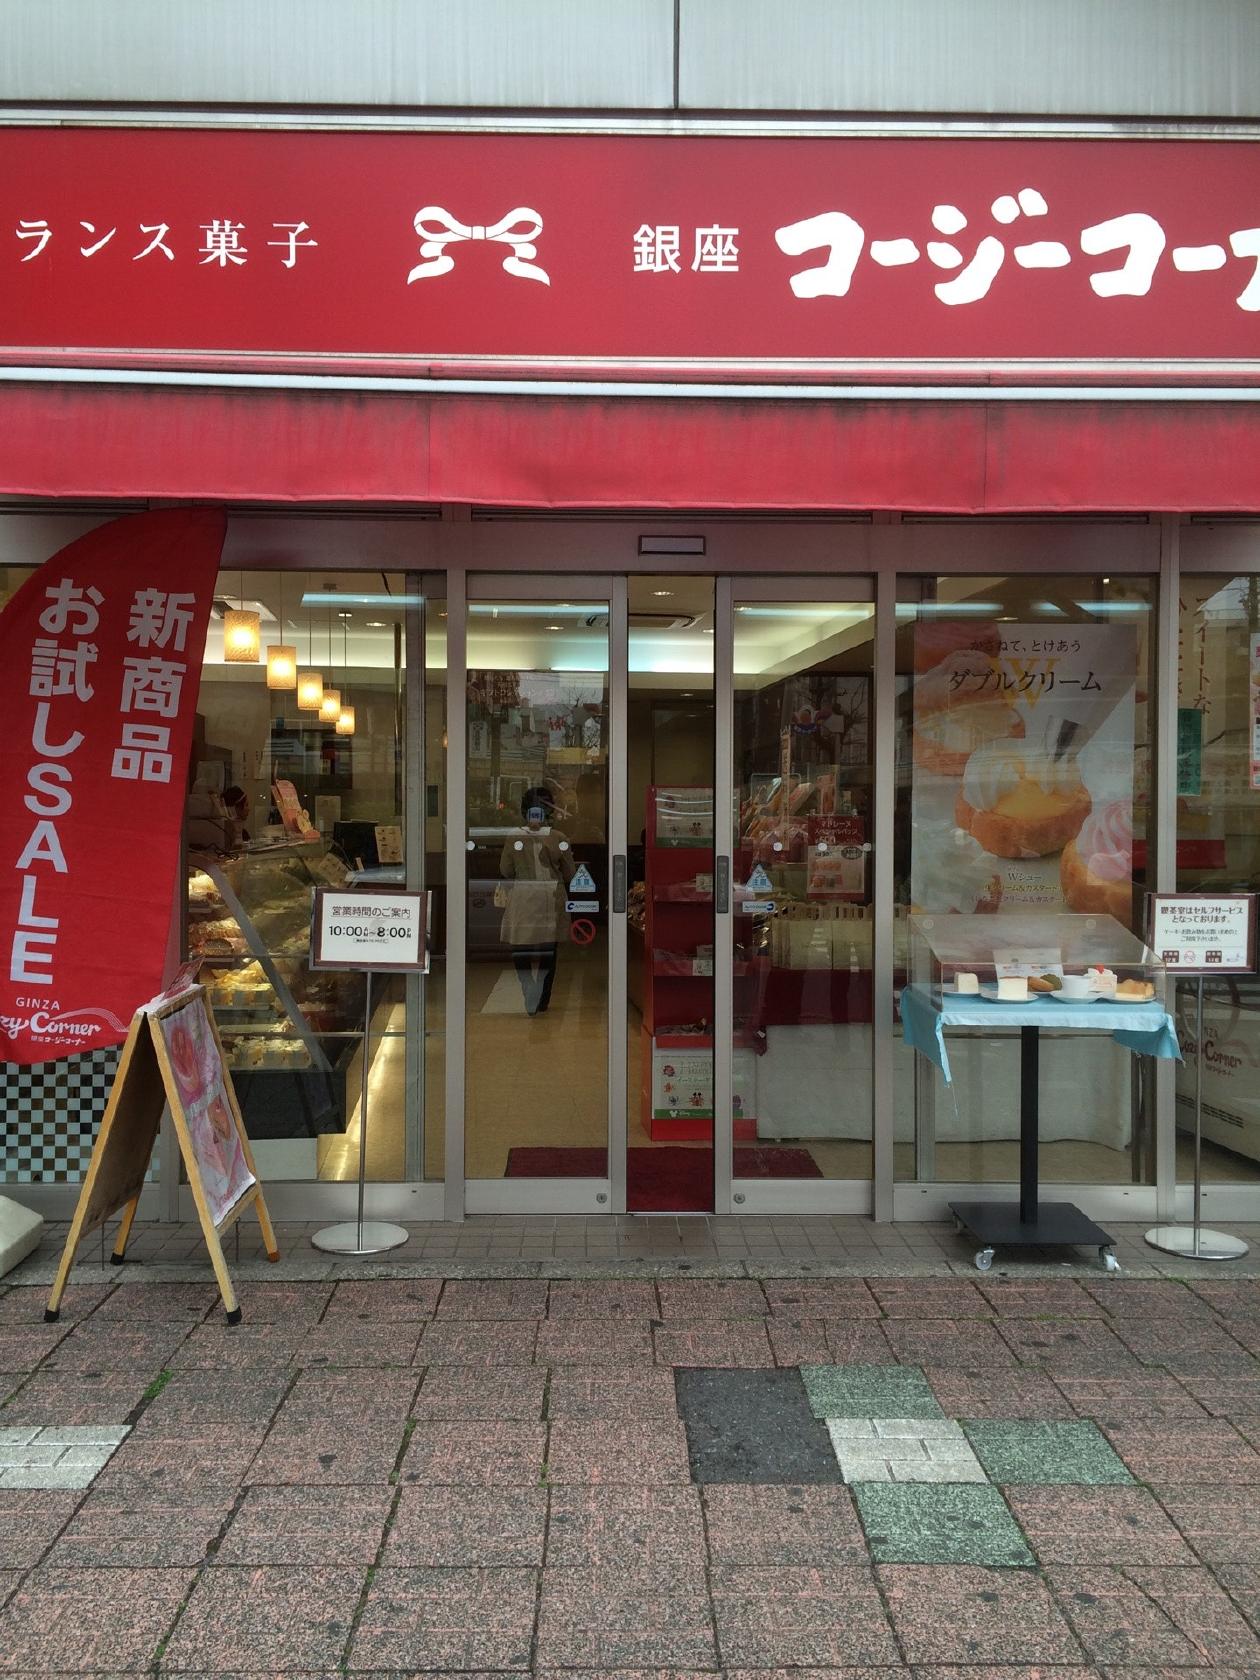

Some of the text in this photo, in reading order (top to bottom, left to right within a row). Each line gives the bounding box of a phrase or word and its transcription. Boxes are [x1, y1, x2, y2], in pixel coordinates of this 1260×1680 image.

[632, 223, 741, 274] 銀座
[110, 587, 196, 784] 新商品
[949, 669, 1102, 693] ダブルクリーム
[332, 906, 411, 918] 営業時間のご案内
[15, 996, 61, 1011] GINZA
[30, 1011, 102, 1037] Corner
